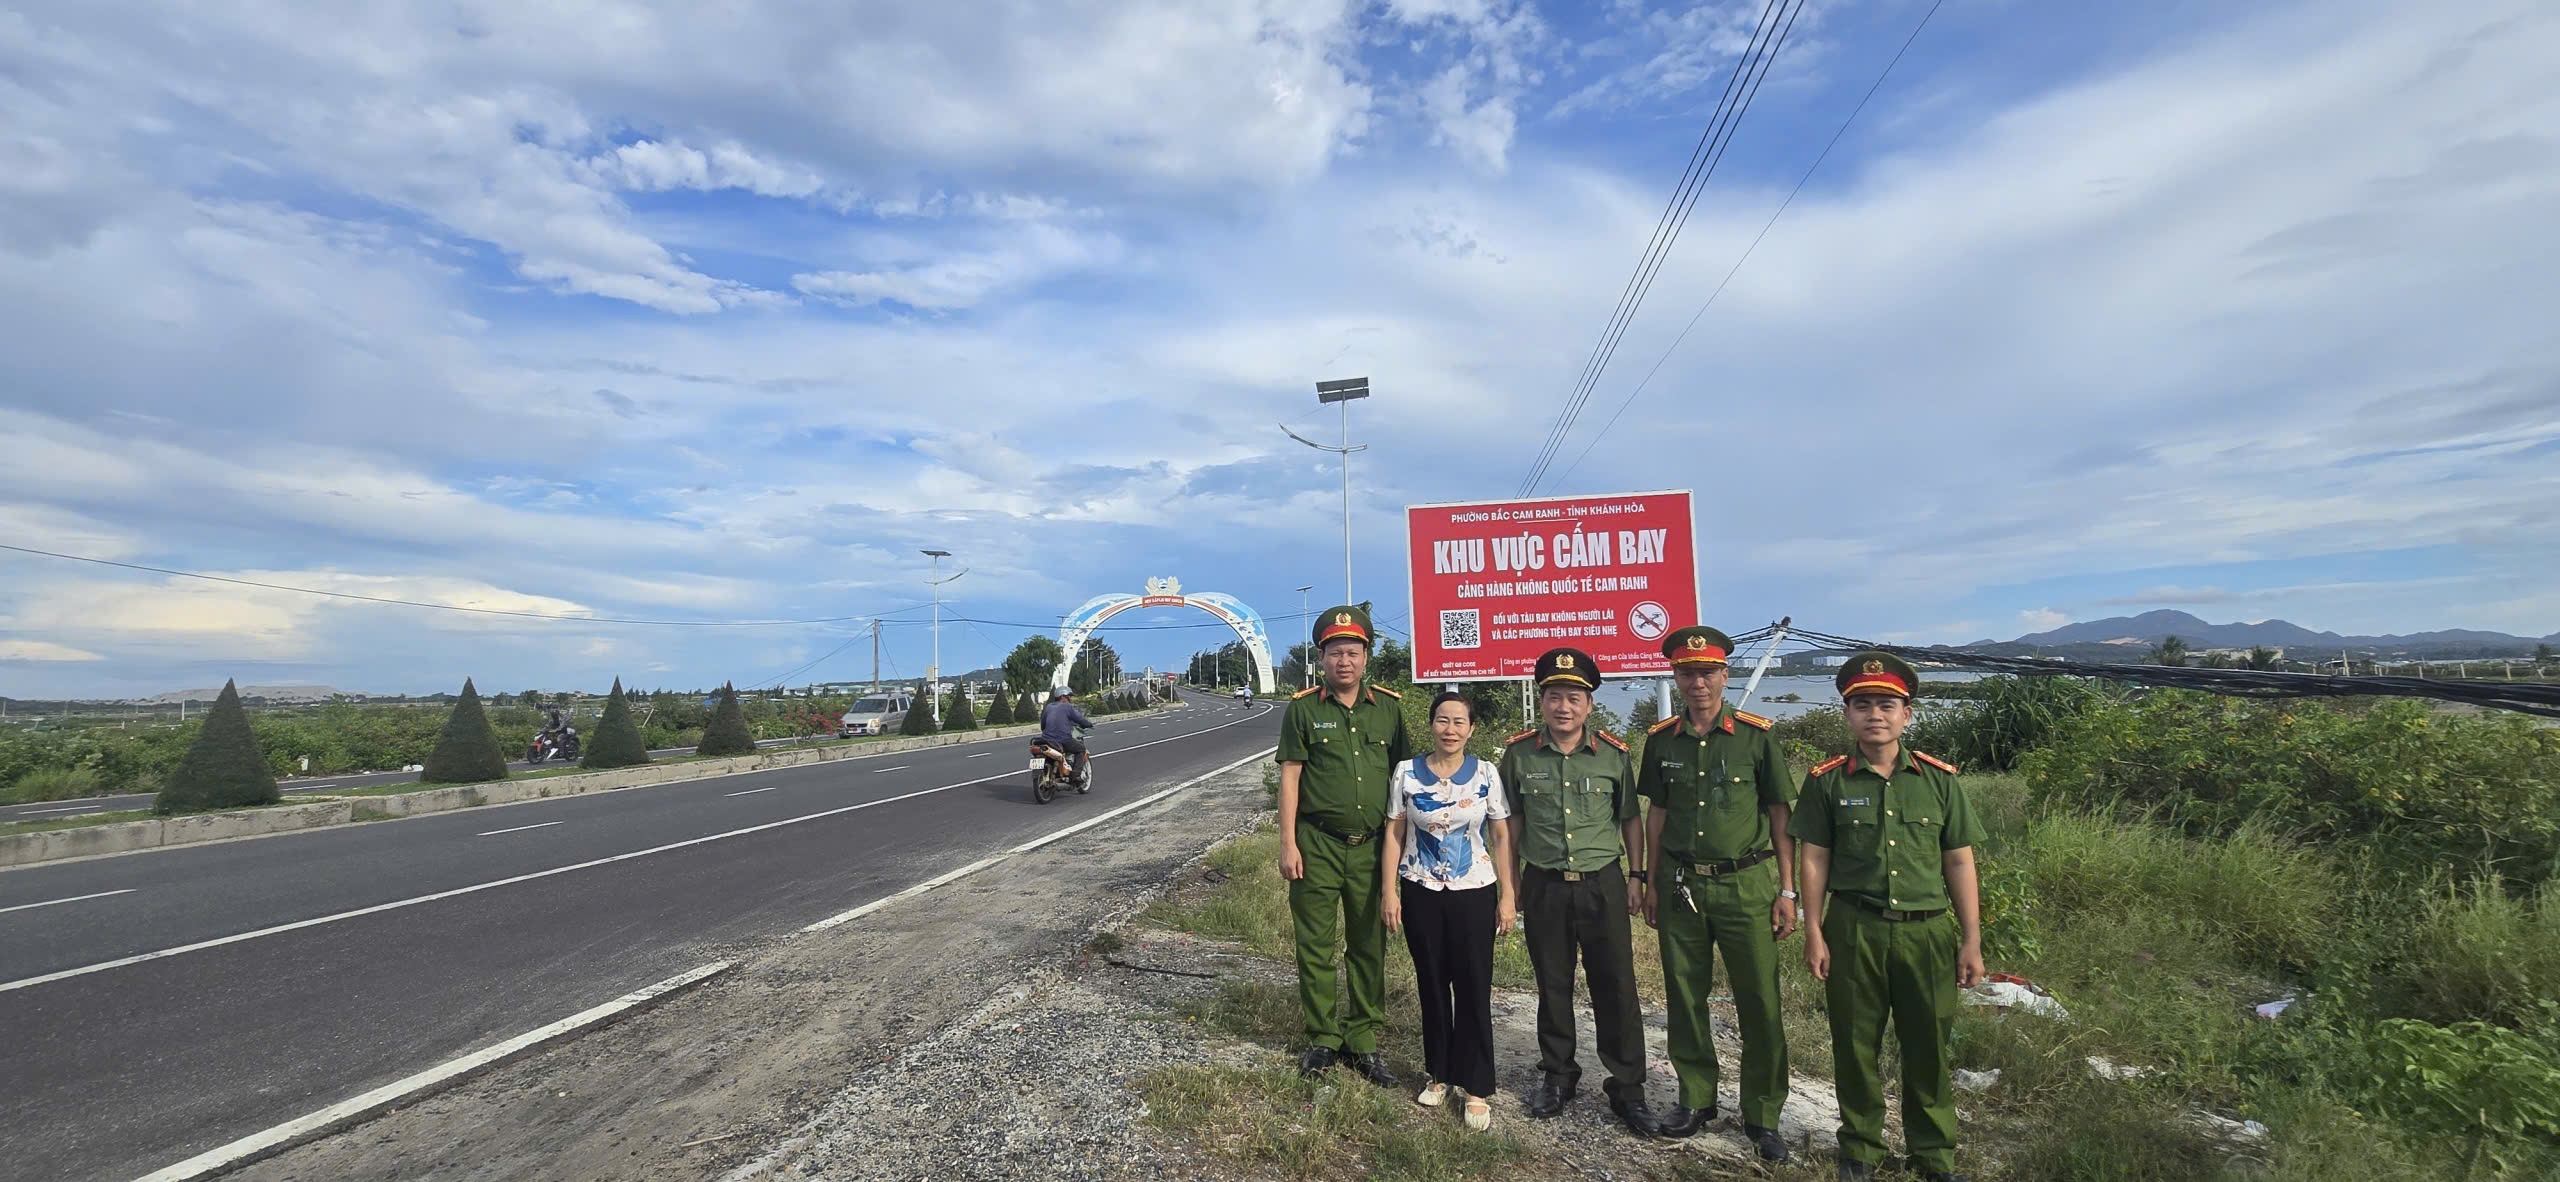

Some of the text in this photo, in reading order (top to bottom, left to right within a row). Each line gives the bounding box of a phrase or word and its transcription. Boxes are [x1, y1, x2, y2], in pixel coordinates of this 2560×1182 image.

[1452, 511, 1488, 523] PHƯỜNG
[1491, 508, 1510, 521] BẮC
[1513, 510, 1533, 519] CAM
[1536, 509, 1560, 518] RANH
[1567, 505, 1587, 516] TỈNH
[1590, 504, 1621, 515] KHÁNH
[1624, 502, 1645, 513] HÒA
[1433, 522, 1667, 577] KHU VỰC CẤM BAY
[1458, 575, 1648, 599] CẢNG HÀNG KHÔNG QUỐC TẾ CAM RANH
[1493, 612, 1506, 624] ĐỐI
[1521, 612, 1534, 623] TÀU
[1536, 613, 1549, 622] BAY
[1551, 610, 1576, 622] KHÔNG
[1578, 609, 1600, 620] NGƯỜI
[1602, 608, 1614, 619] LÁI
[1491, 625, 1617, 640] VÀ CÁC PHƯƠNG TIỆN BAY SIÊU NHẸ
